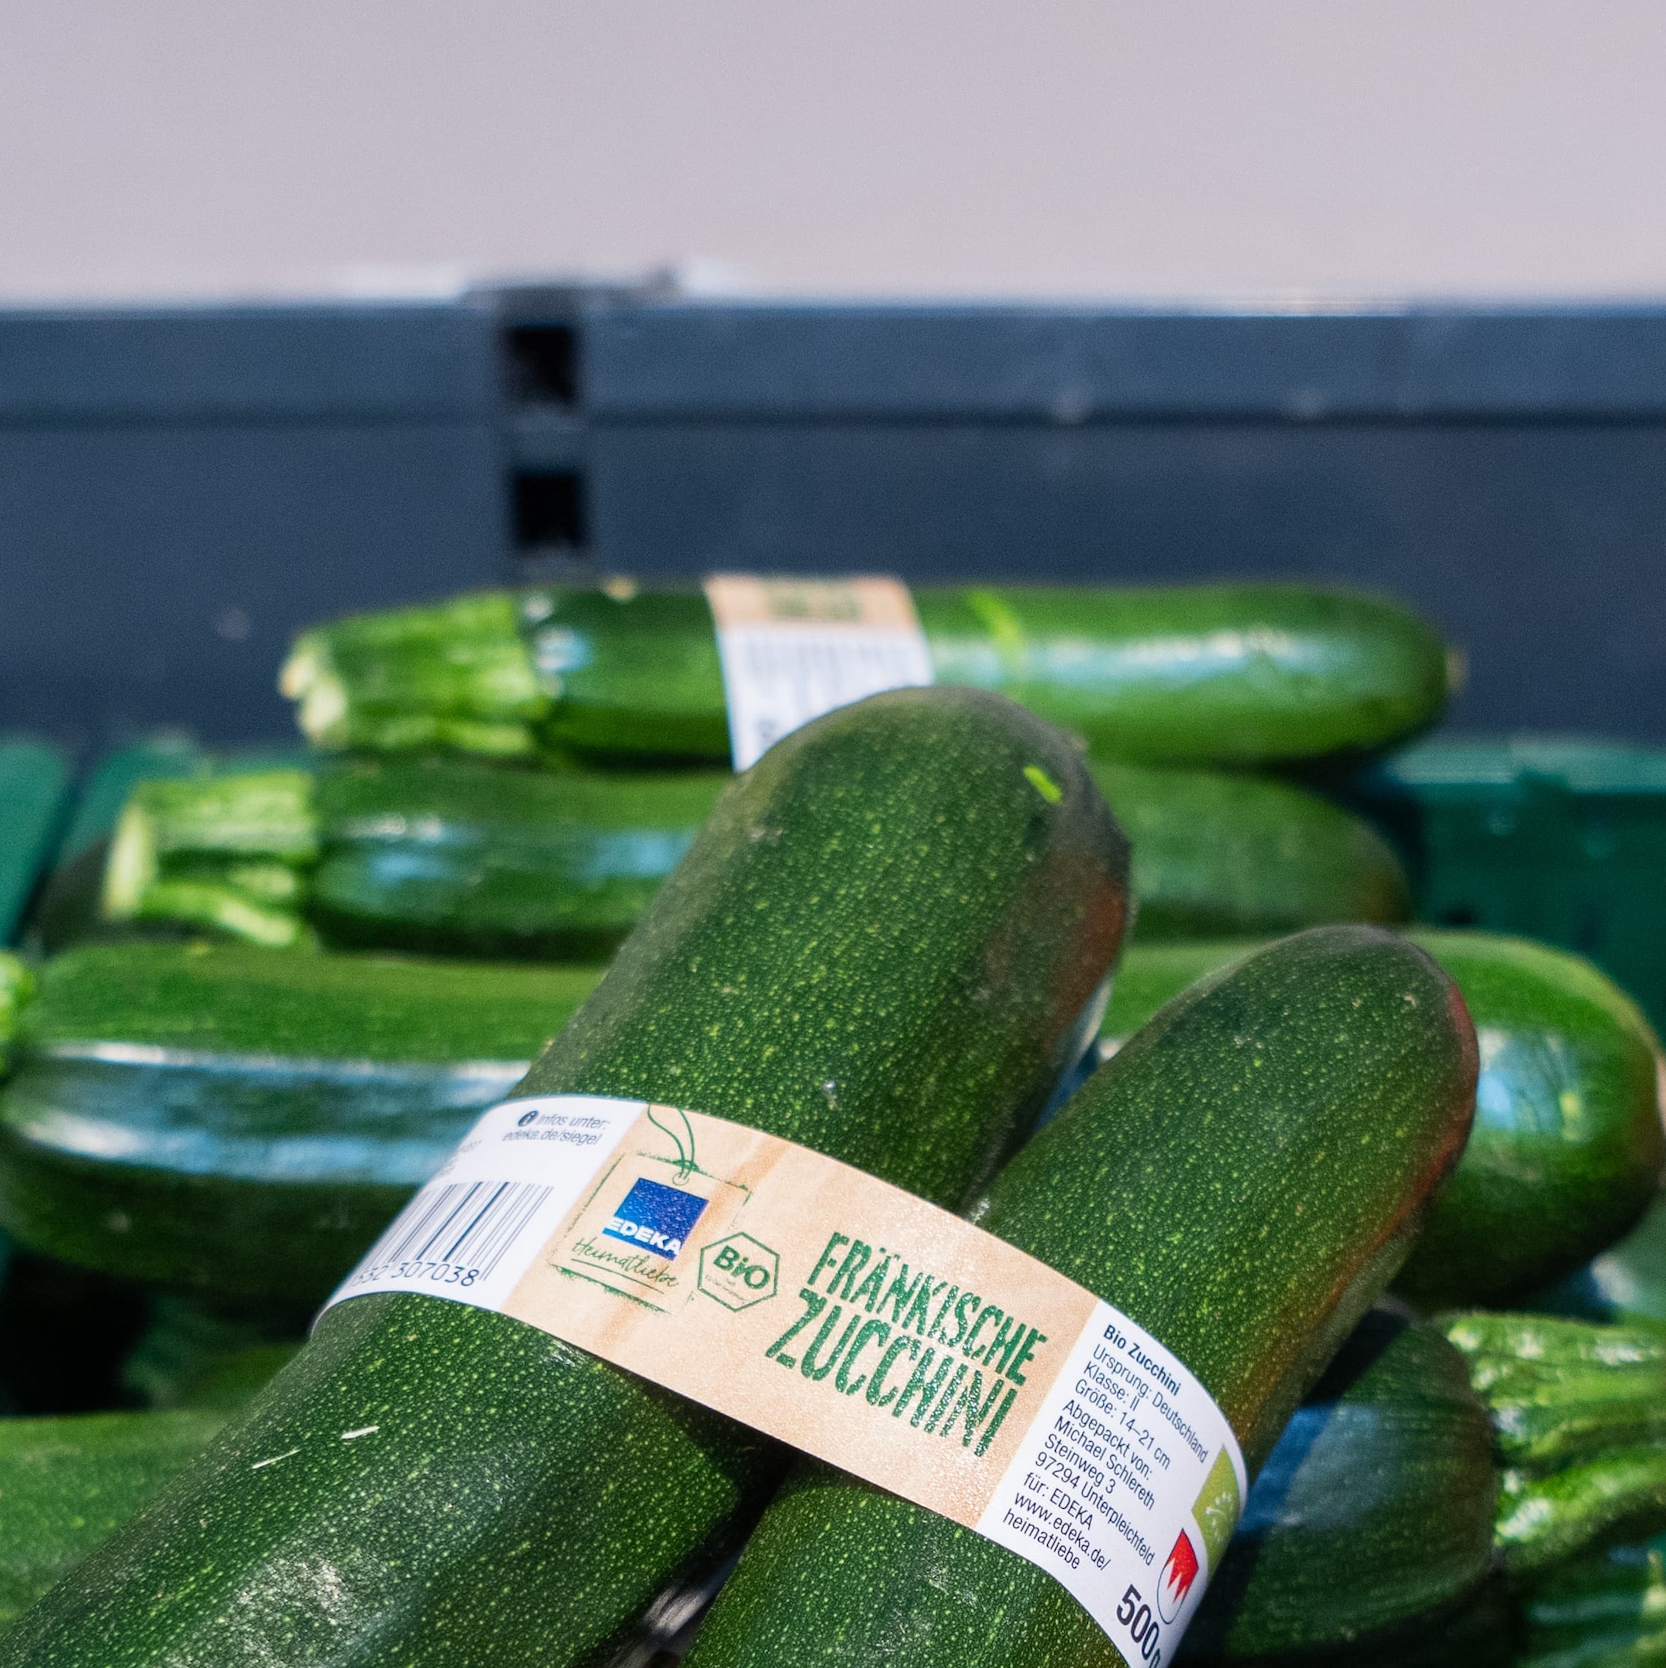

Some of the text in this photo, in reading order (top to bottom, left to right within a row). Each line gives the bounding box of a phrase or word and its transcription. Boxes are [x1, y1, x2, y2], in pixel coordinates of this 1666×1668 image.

[502, 1129, 603, 1146] edeka.de/siegel
[536, 1113, 610, 1130] Infos unter:
[571, 1236, 680, 1288] Heimatliebe
[605, 1217, 683, 1255] EDEKA
[391, 1261, 480, 1287] 307038
[806, 1231, 1048, 1387] FRÄNKISCHE
[764, 1288, 1018, 1457] ZUCCHINI
[1083, 1361, 1129, 1404] Klasse:
[1103, 1324, 1182, 1396] Bio Zucchini
[1075, 1378, 1115, 1417] Größe:
[1154, 1449, 1172, 1470] cm
[1093, 1344, 1208, 1463] Ursprung: Deutschland
[1044, 1433, 1116, 1494] Steinweg 3
[1053, 1416, 1156, 1511] Michael Schlereth
[1062, 1399, 1153, 1481] Abgepackt von:
[1014, 1492, 1113, 1571] www.edeka.de/
[1024, 1472, 1095, 1530] für: EDEKA
[1034, 1451, 1156, 1566] 97294 Unterpleichfeld
[1003, 1508, 1082, 1569] heimatliebe
